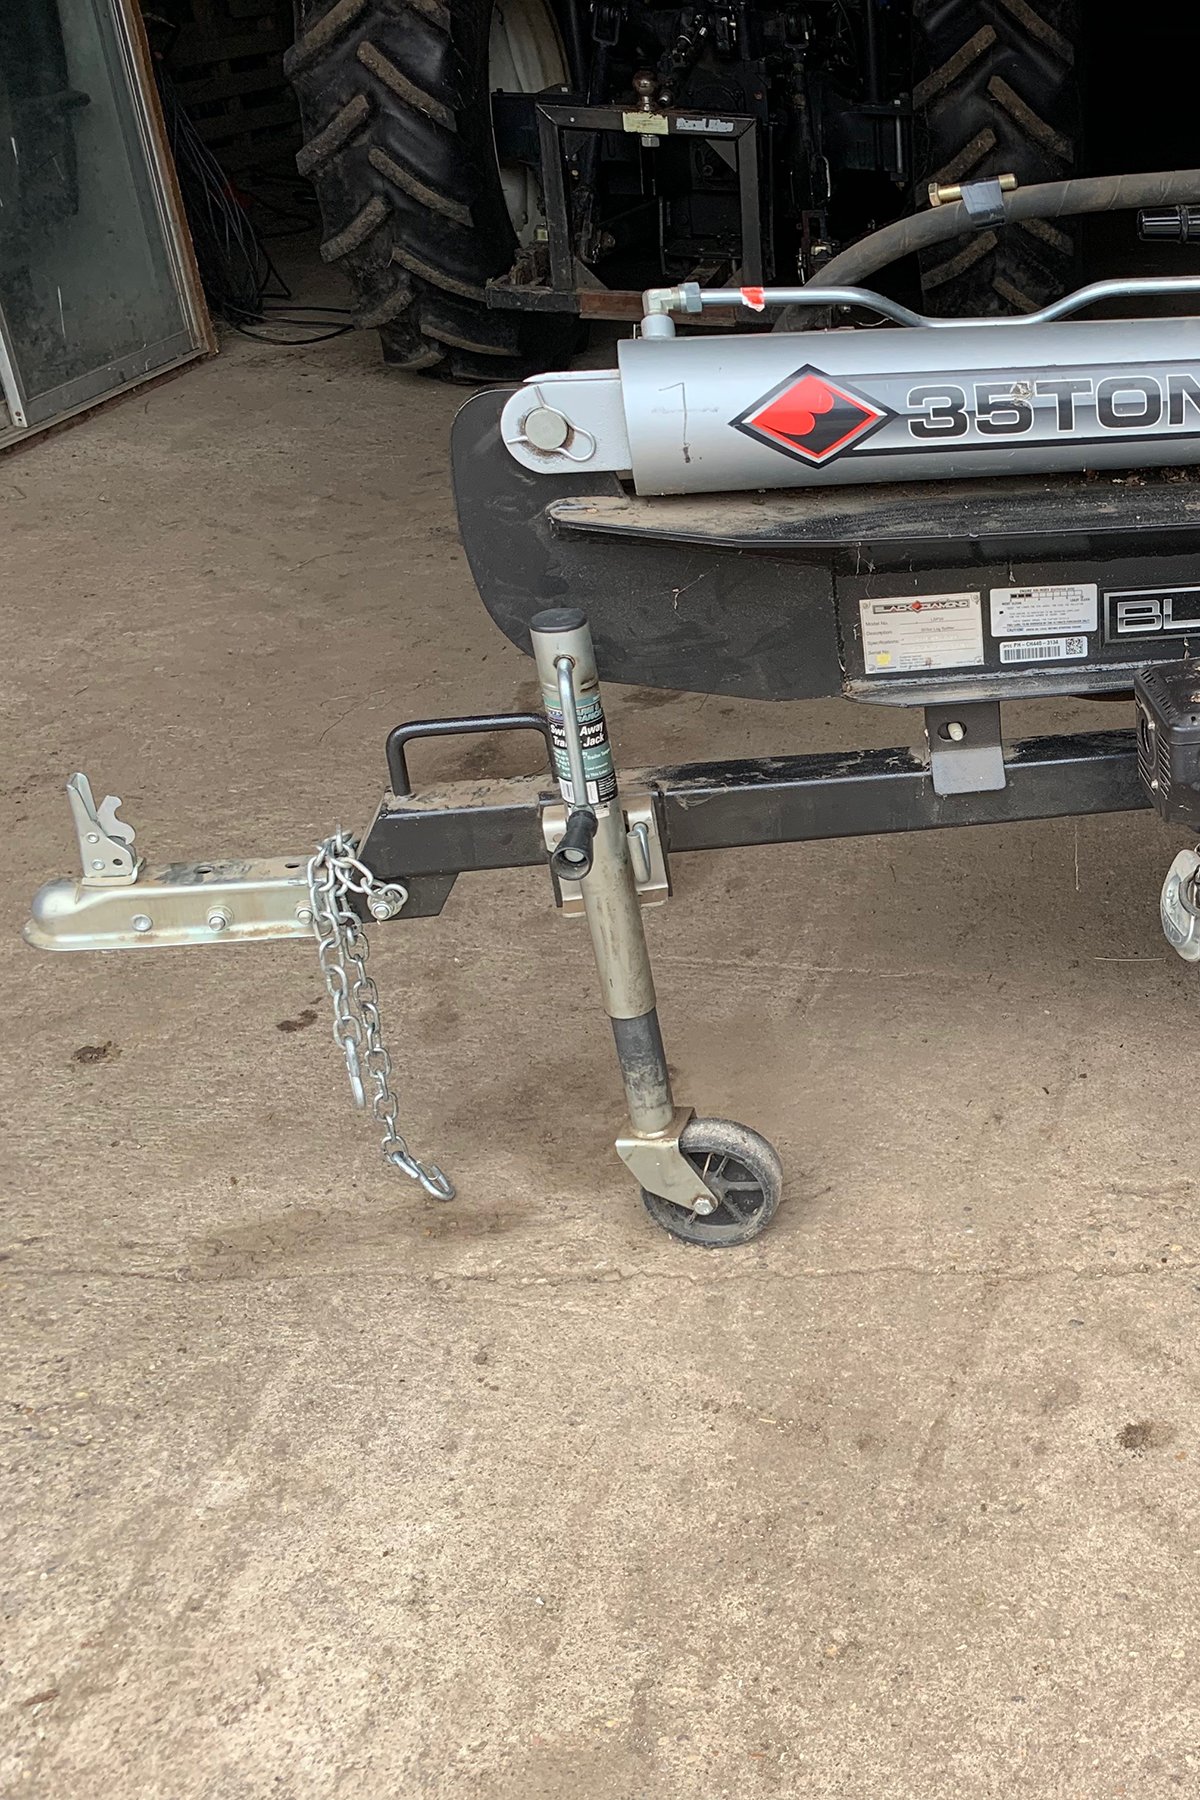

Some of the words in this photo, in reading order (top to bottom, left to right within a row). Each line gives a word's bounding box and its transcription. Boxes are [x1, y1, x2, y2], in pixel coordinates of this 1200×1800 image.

[919, 600, 968, 611] DIAMOND
[579, 721, 604, 737] Away
[582, 733, 605, 748] Jack
